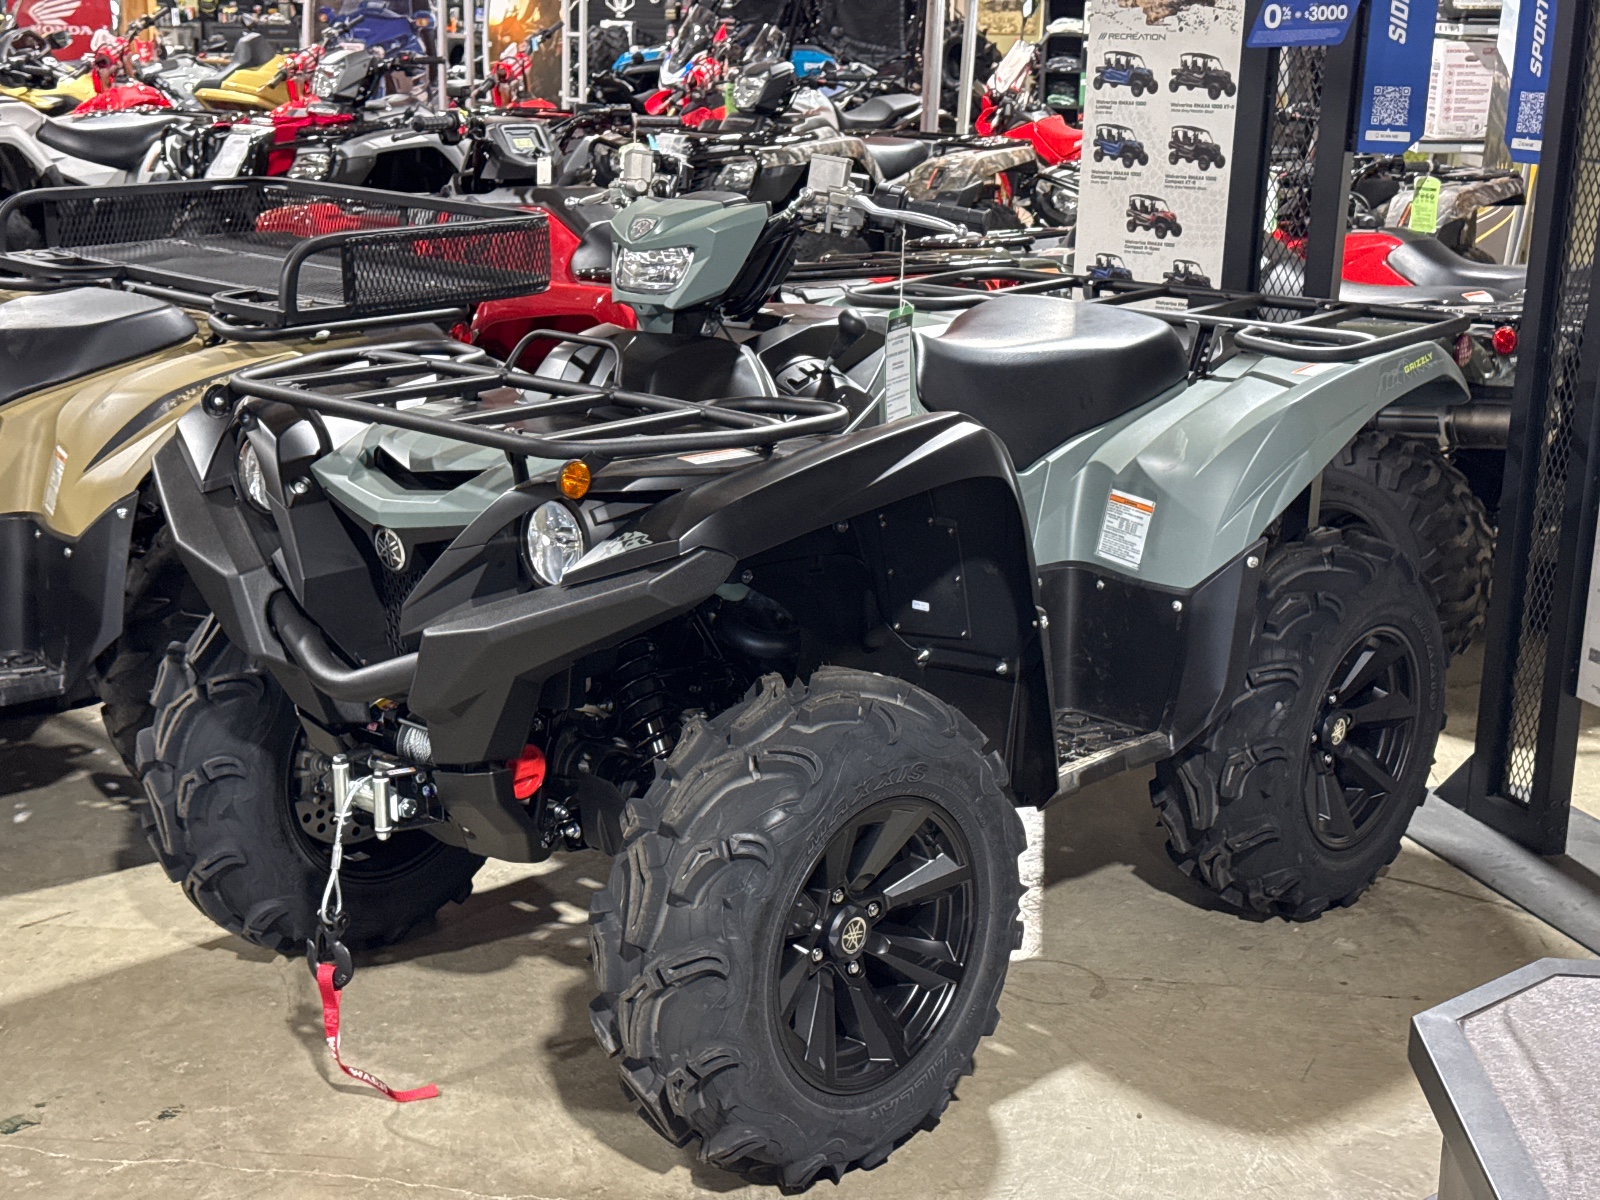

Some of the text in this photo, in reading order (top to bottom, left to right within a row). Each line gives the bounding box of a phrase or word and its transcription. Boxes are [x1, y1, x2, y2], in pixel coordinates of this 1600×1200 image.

[1304, 4, 1348, 22] $3000
[1388, 0, 1410, 45] SID
[30, 24, 94, 36] HONDA
[1107, 33, 1167, 41] RECREATION
[1529, 0, 1549, 78] SPORT
[1403, 352, 1433, 374] GRIZZLY
[805, 761, 929, 855] MAXXIS
